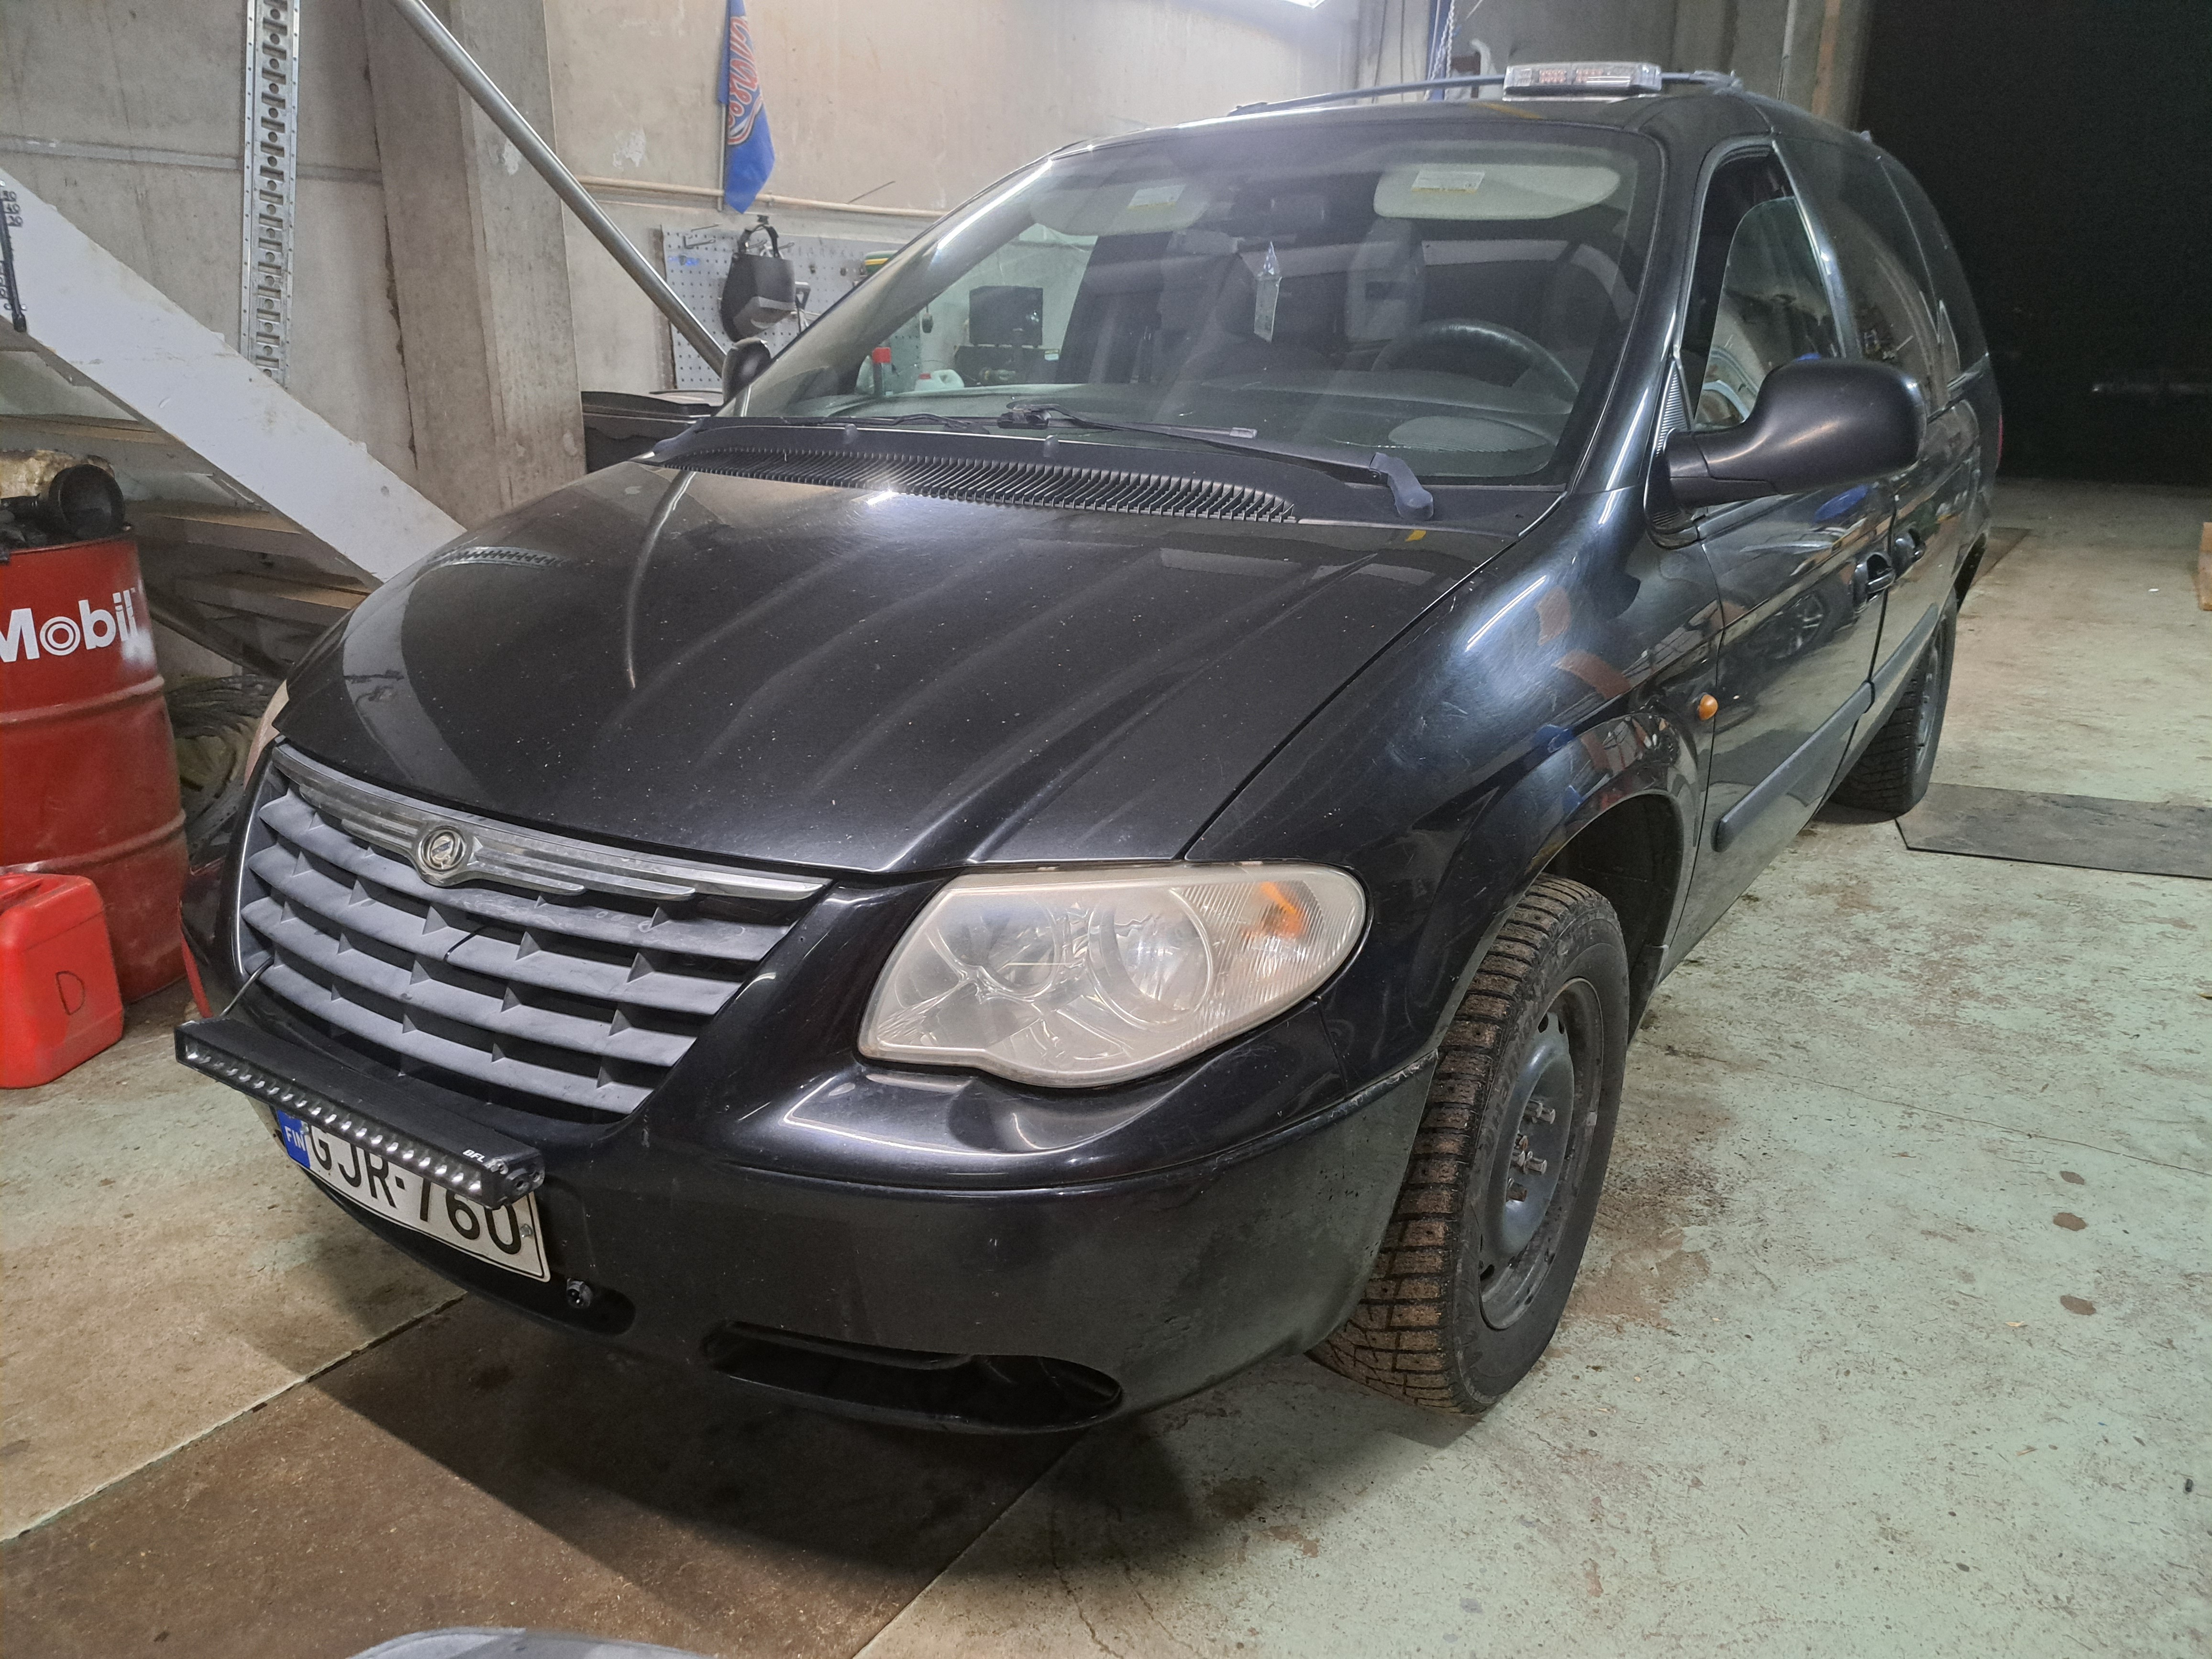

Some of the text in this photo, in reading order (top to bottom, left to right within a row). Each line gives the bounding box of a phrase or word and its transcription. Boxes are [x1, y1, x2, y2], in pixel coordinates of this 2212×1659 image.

[0, 590, 138, 663] Mobil
[55, 970, 86, 1016] D
[284, 1126, 306, 1151] FIN
[463, 1149, 485, 1162] BFL
